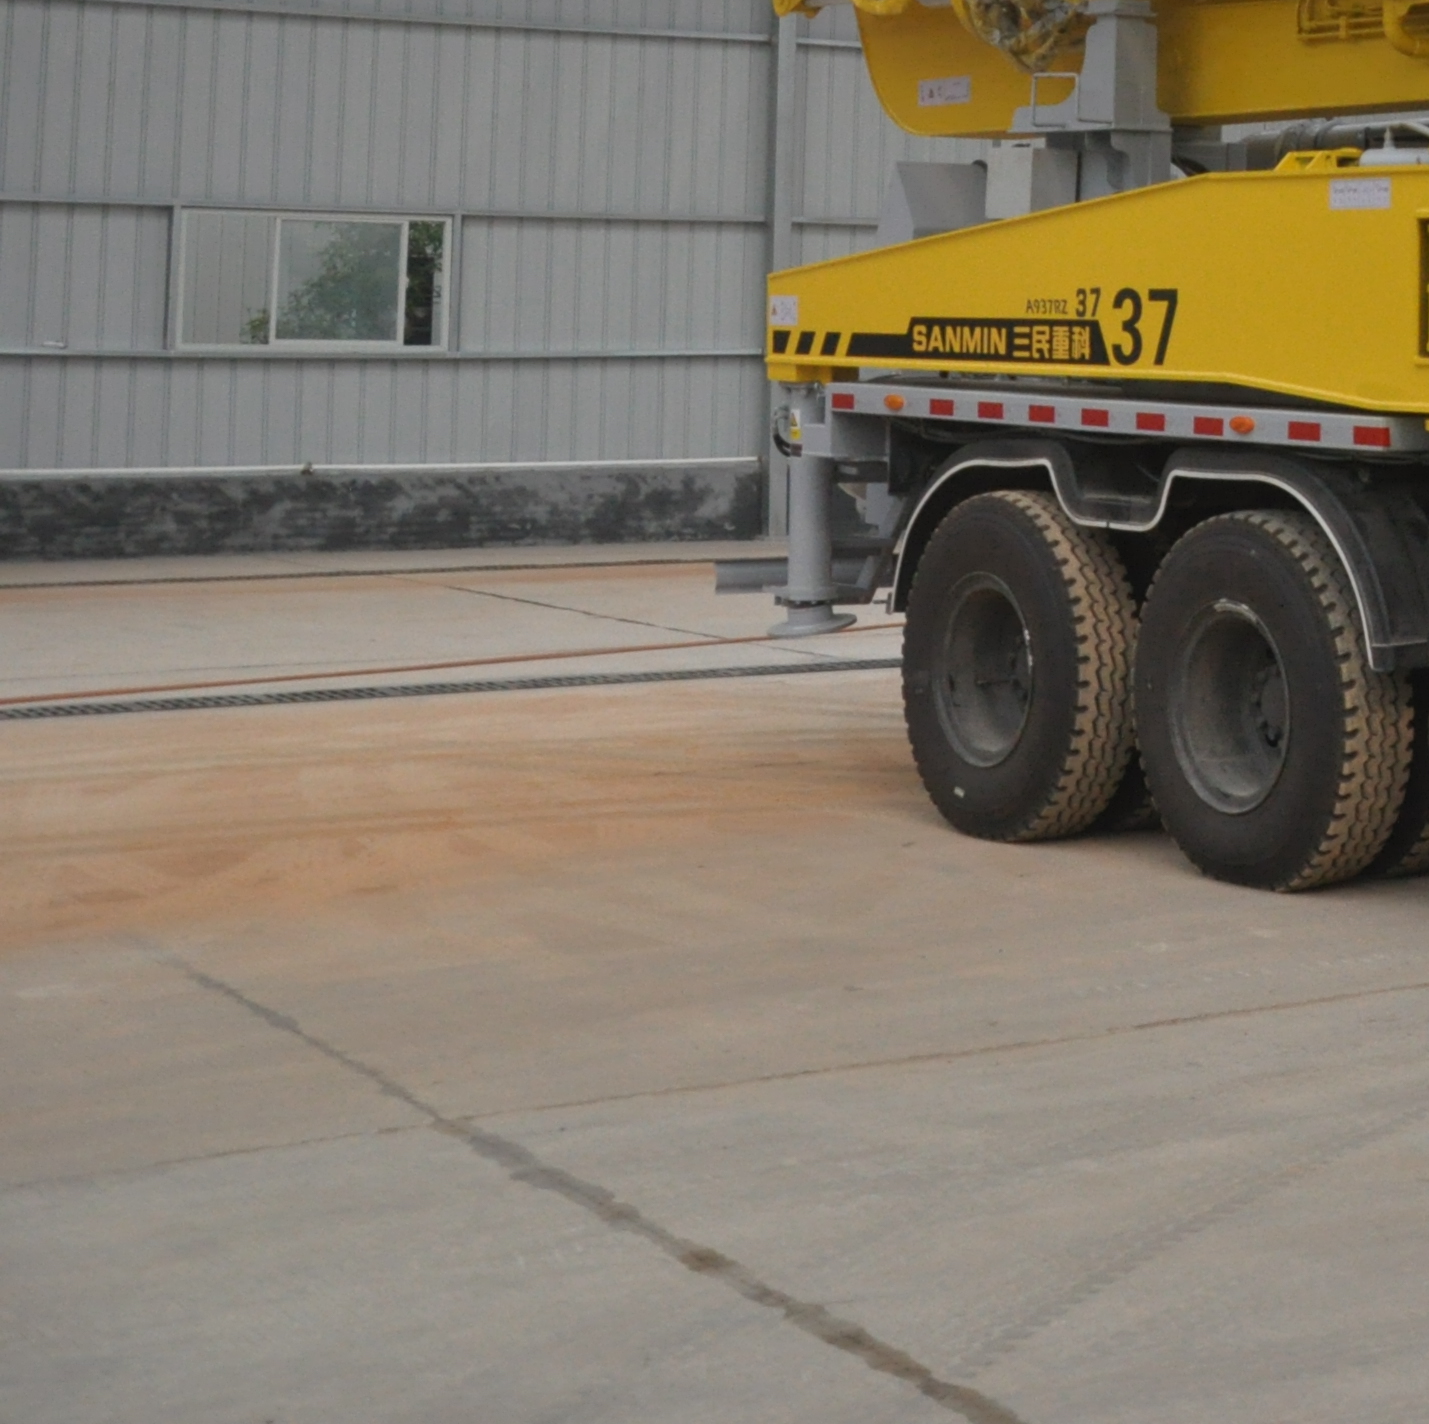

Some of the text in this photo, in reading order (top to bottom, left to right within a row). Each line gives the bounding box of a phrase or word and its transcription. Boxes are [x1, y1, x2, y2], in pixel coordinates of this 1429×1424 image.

[1025, 287, 1101, 318] A937RZ 37
[912, 324, 1091, 361] SANMIN 三民重科
[1111, 287, 1178, 366] 37
